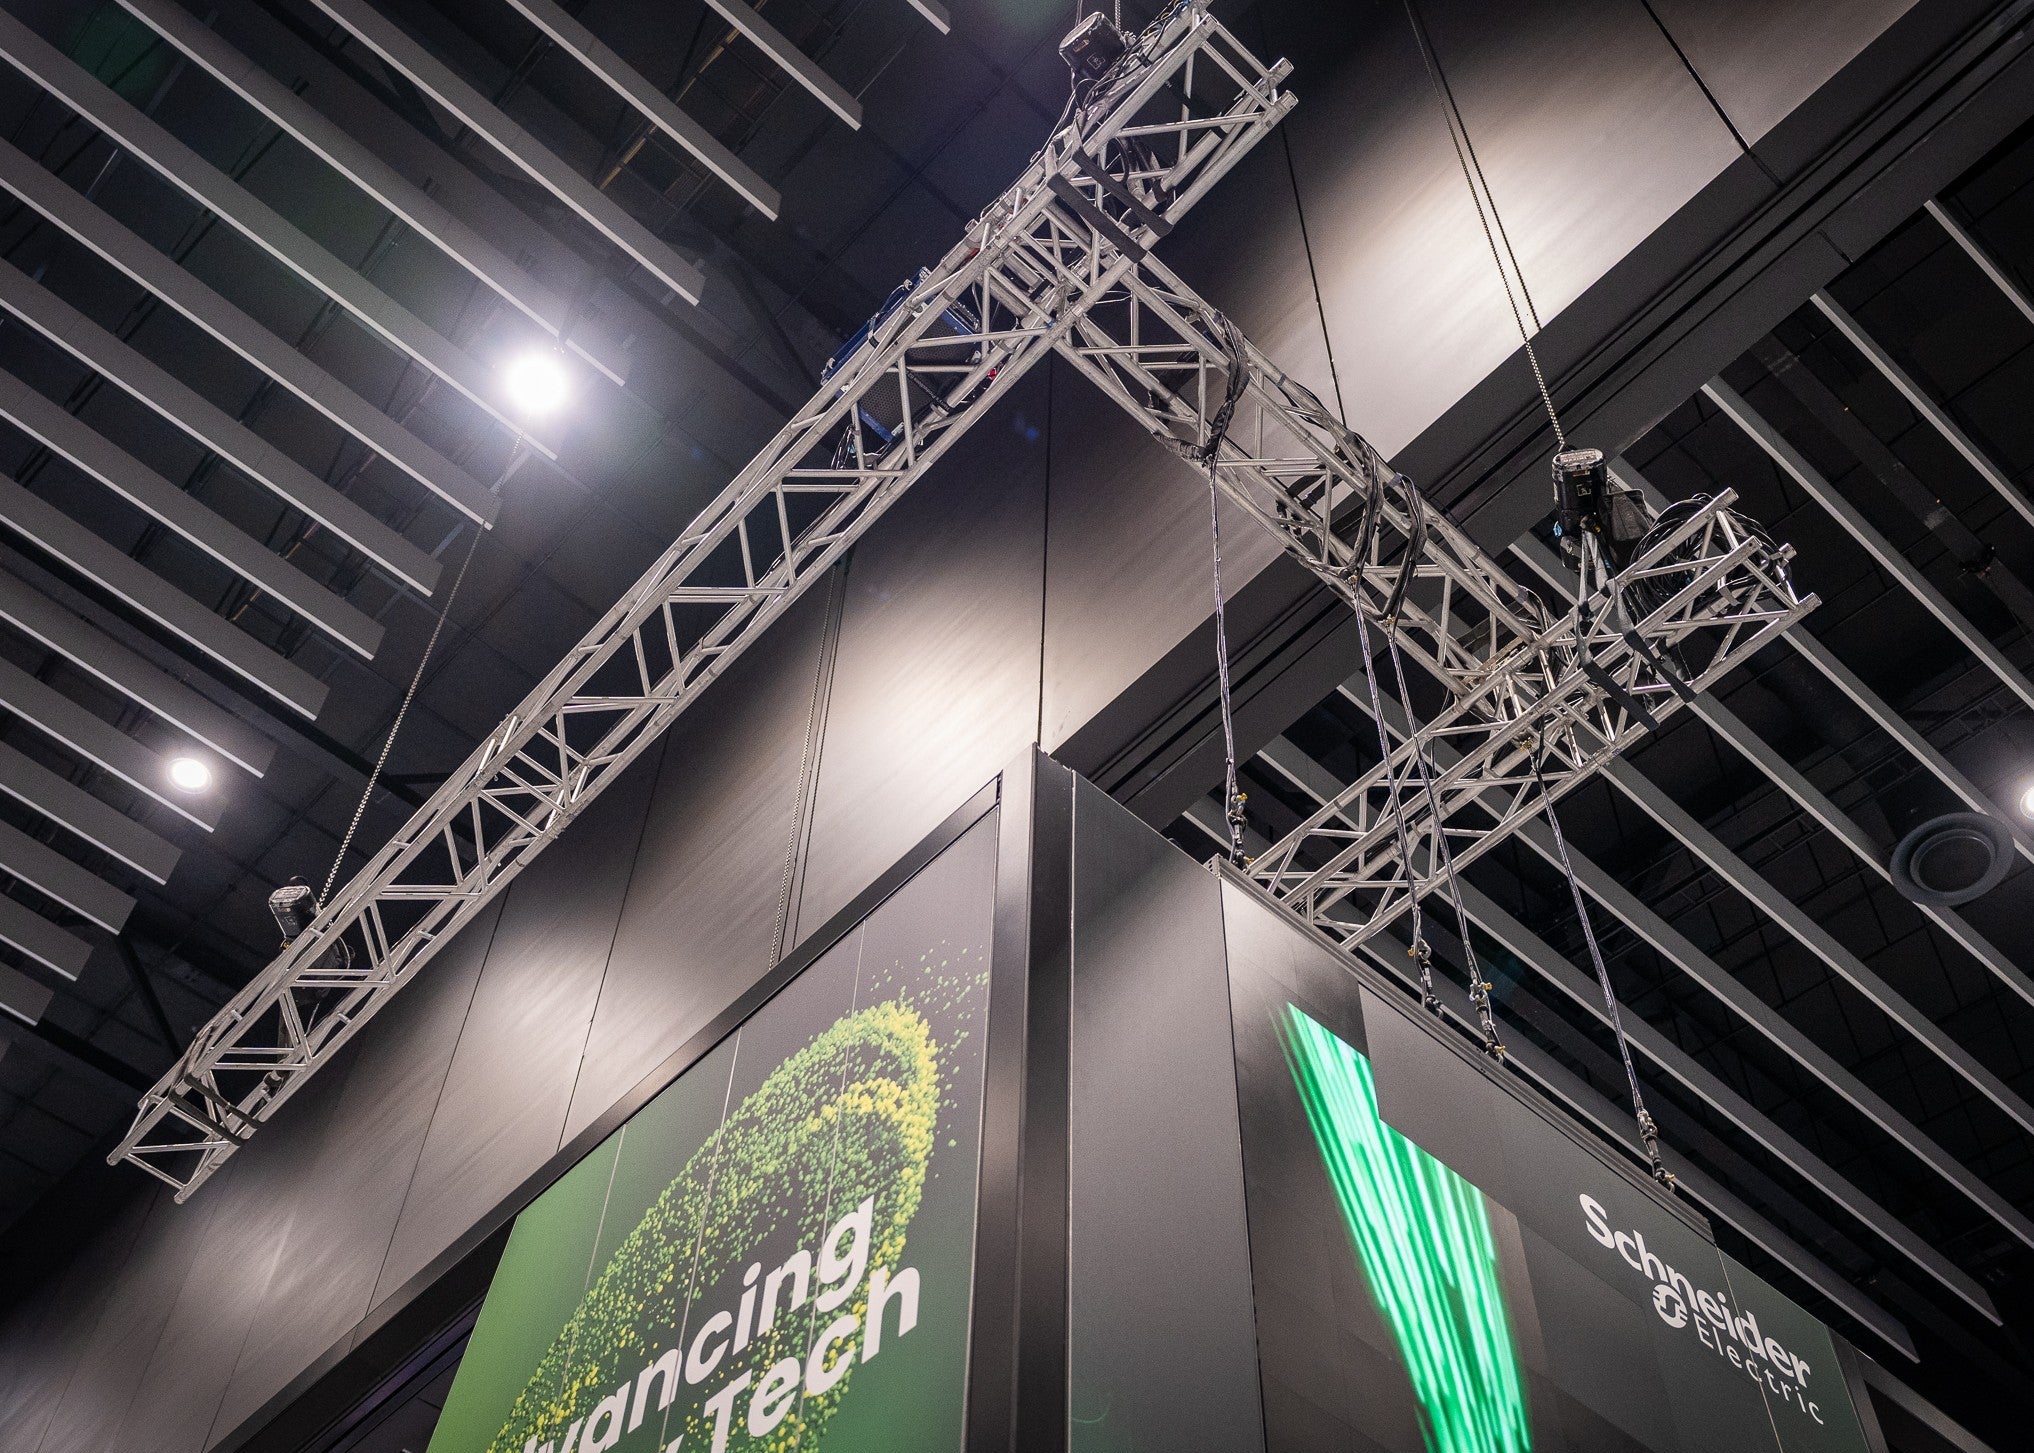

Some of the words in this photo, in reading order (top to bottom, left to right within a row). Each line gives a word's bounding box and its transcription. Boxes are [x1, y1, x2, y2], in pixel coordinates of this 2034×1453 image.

[523, 1195, 874, 1453] ancing
[703, 1265, 921, 1453] Tech
[1579, 1193, 1811, 1388] Schneider
[1692, 1312, 1824, 1425] Electric
